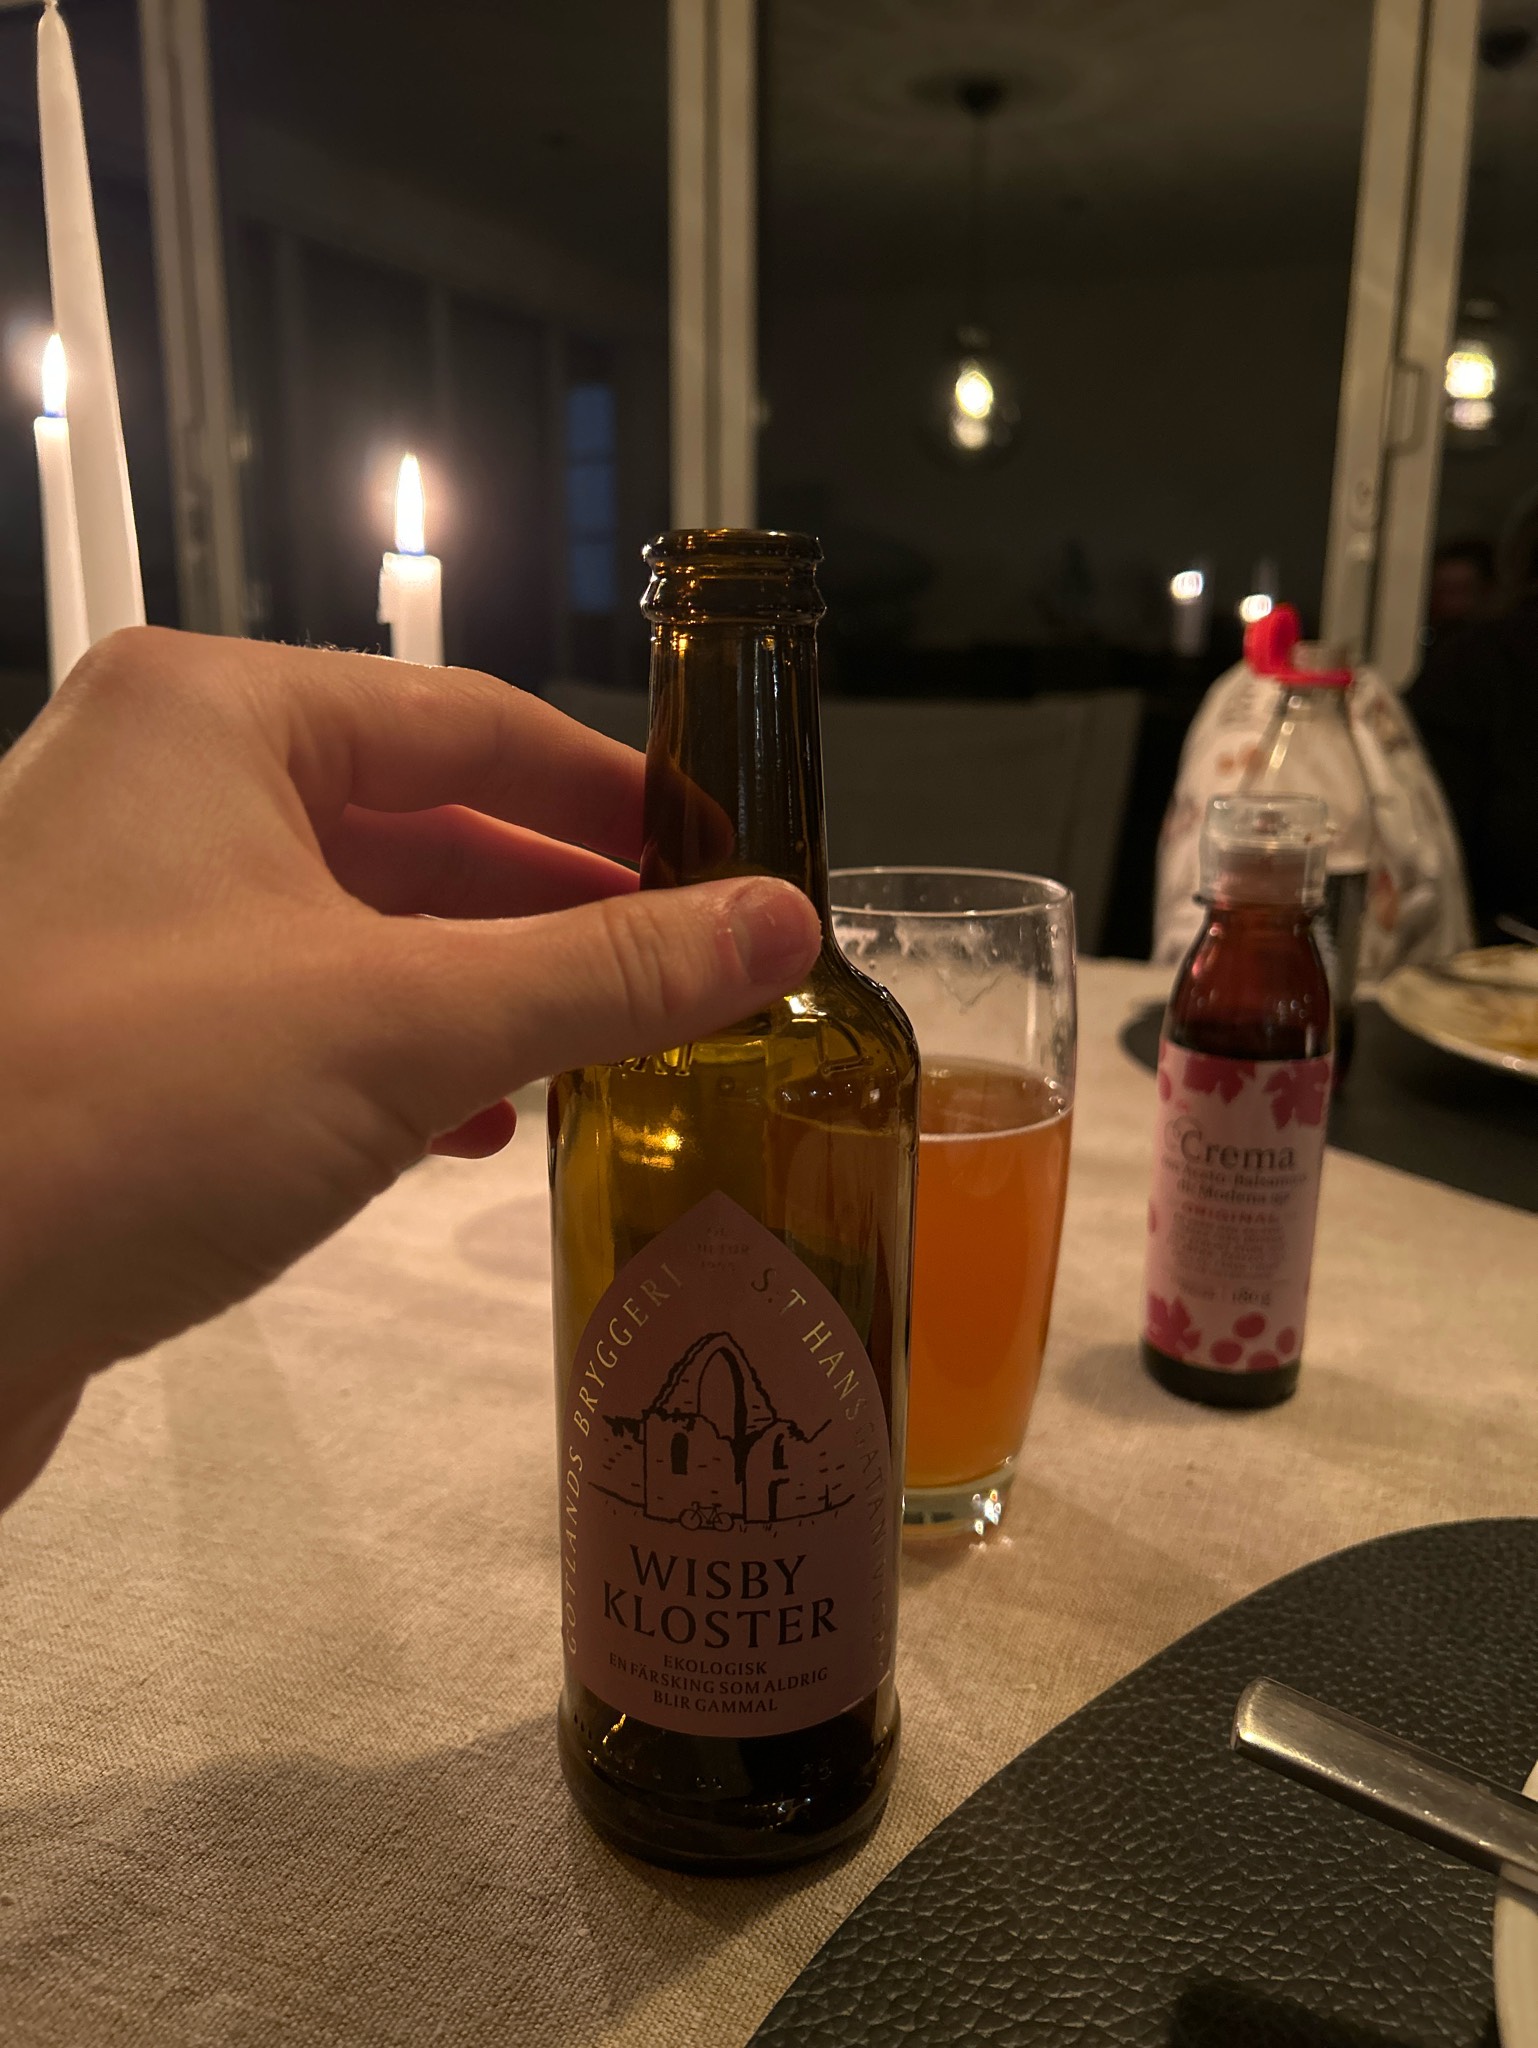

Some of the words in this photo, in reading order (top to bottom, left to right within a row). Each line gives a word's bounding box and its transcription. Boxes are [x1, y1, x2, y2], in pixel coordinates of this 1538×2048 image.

[1180, 1130, 1296, 1170] Crema
[572, 1262, 685, 1437] BRYGGERI
[565, 1445, 584, 1655] GOTLANDS
[629, 1543, 808, 1601] WISBY
[603, 1579, 839, 1650] KLOSTER
[608, 1652, 628, 1673] EN
[629, 1663, 715, 1695] FÄRSKING
[719, 1680, 762, 1695] SOM
[763, 1667, 829, 1694] ALDRIG
[663, 1654, 769, 1676] EKOLOGISK
[653, 1689, 691, 1711] BLIR
[694, 1698, 779, 1714] GAMMAL
